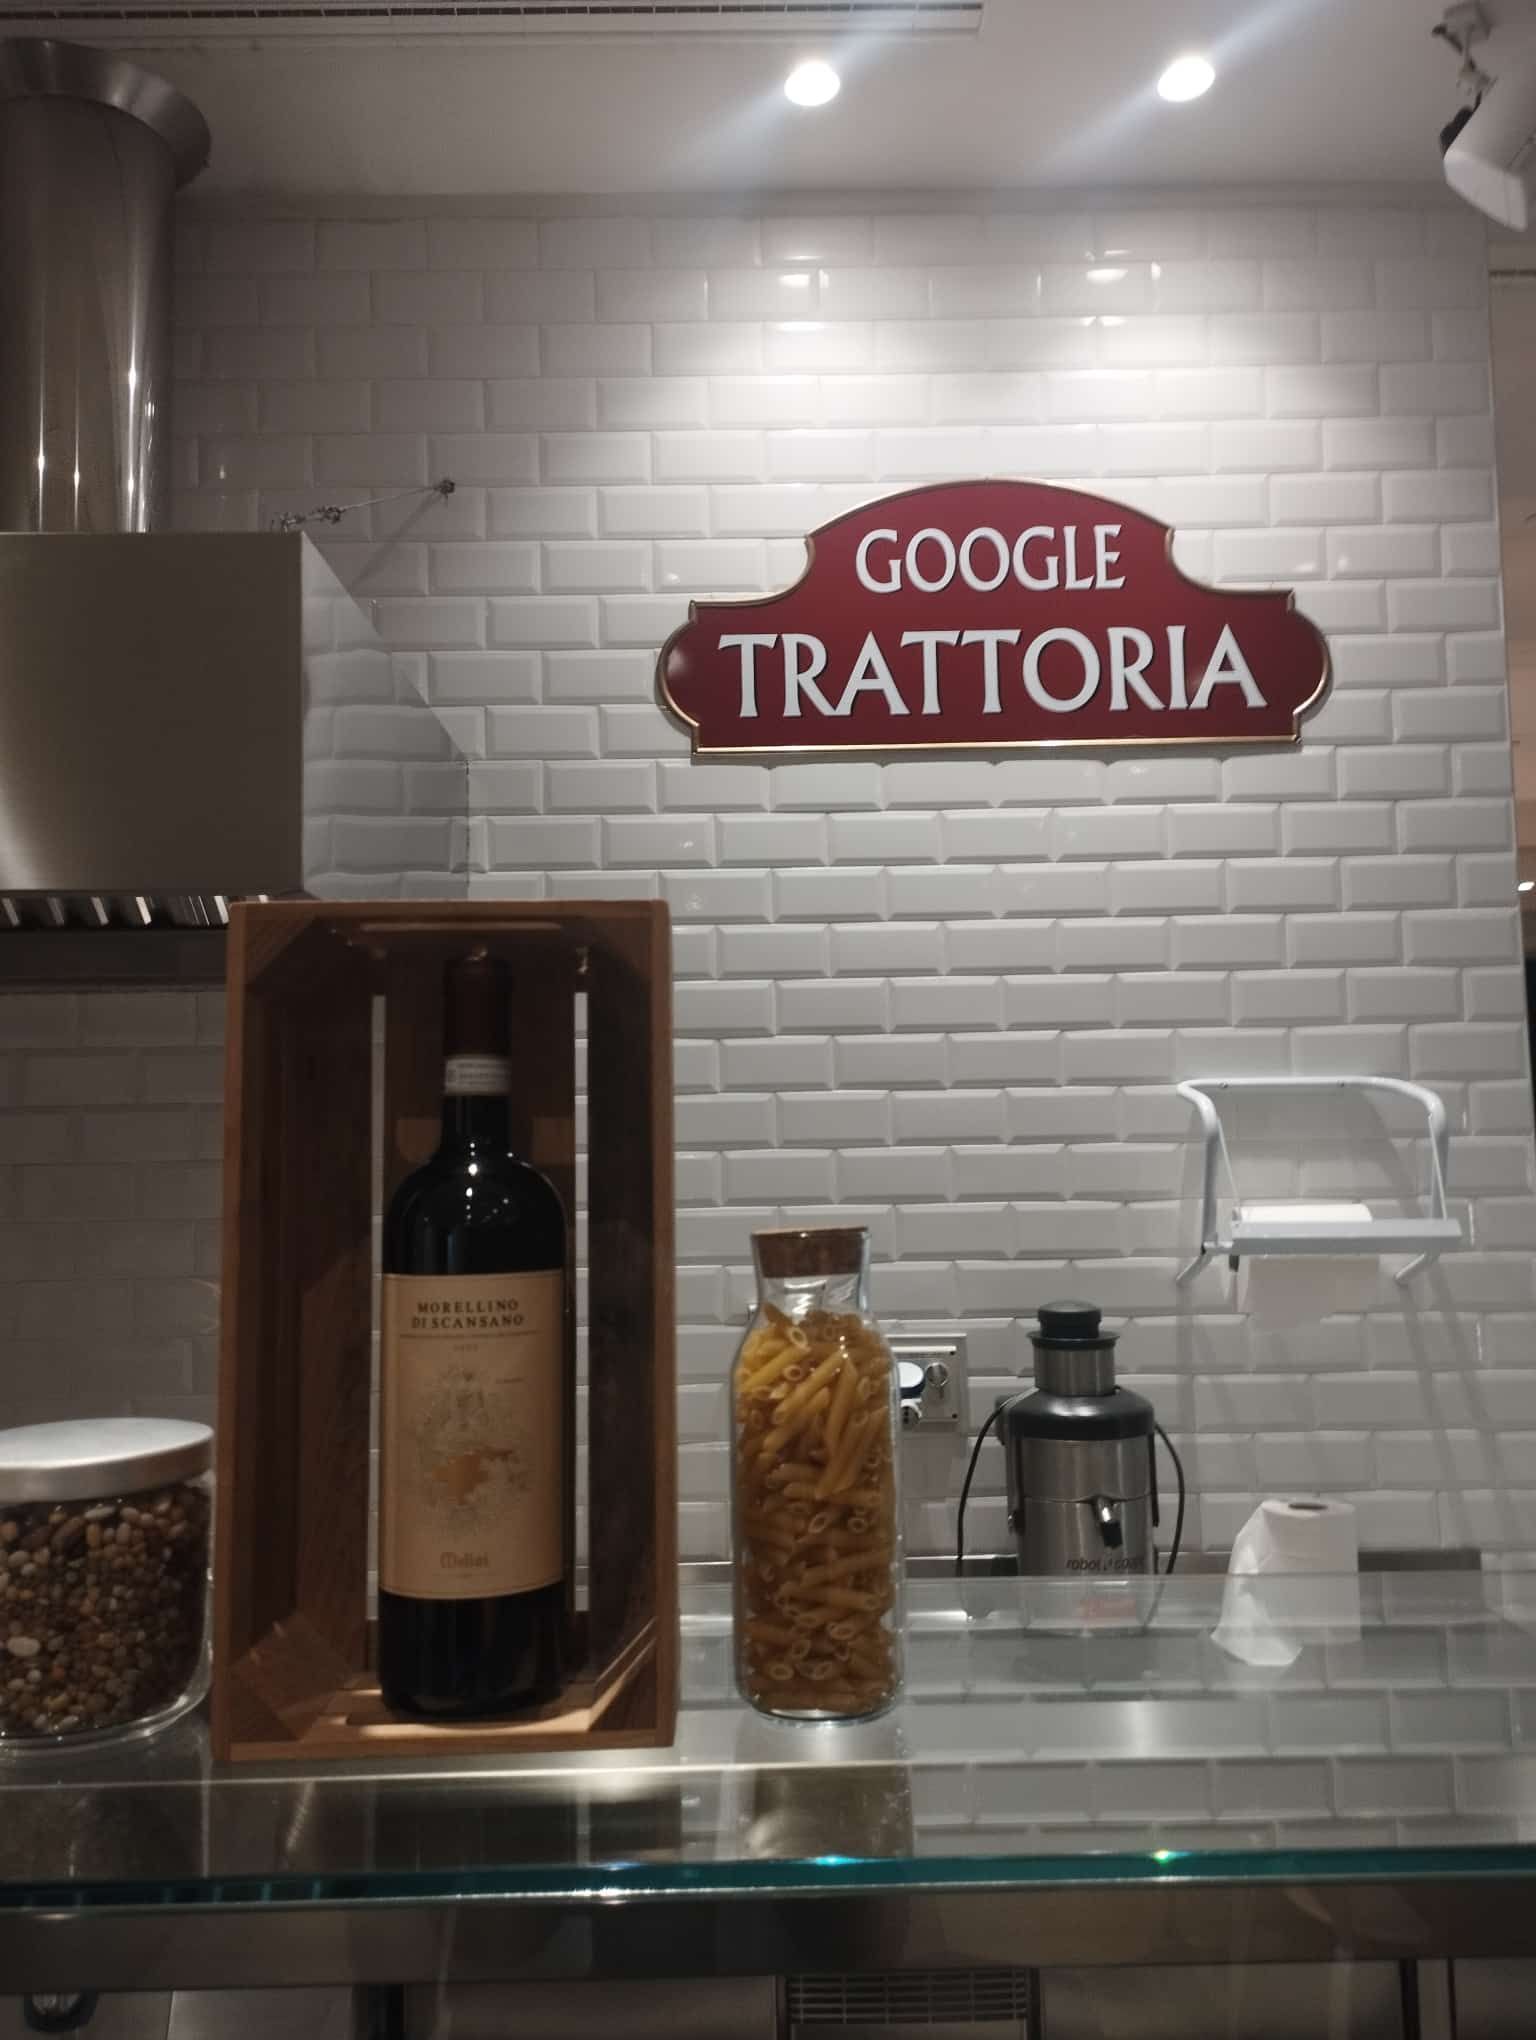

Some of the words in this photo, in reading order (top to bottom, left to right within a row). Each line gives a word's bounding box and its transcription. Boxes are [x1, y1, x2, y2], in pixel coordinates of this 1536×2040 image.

[855, 524, 1126, 594] GOOGLE
[717, 623, 1268, 718] TRATTORIA
[411, 1316, 427, 1329] DI
[430, 1313, 525, 1329] SCANSANO
[416, 1297, 520, 1314] MORELLINO
